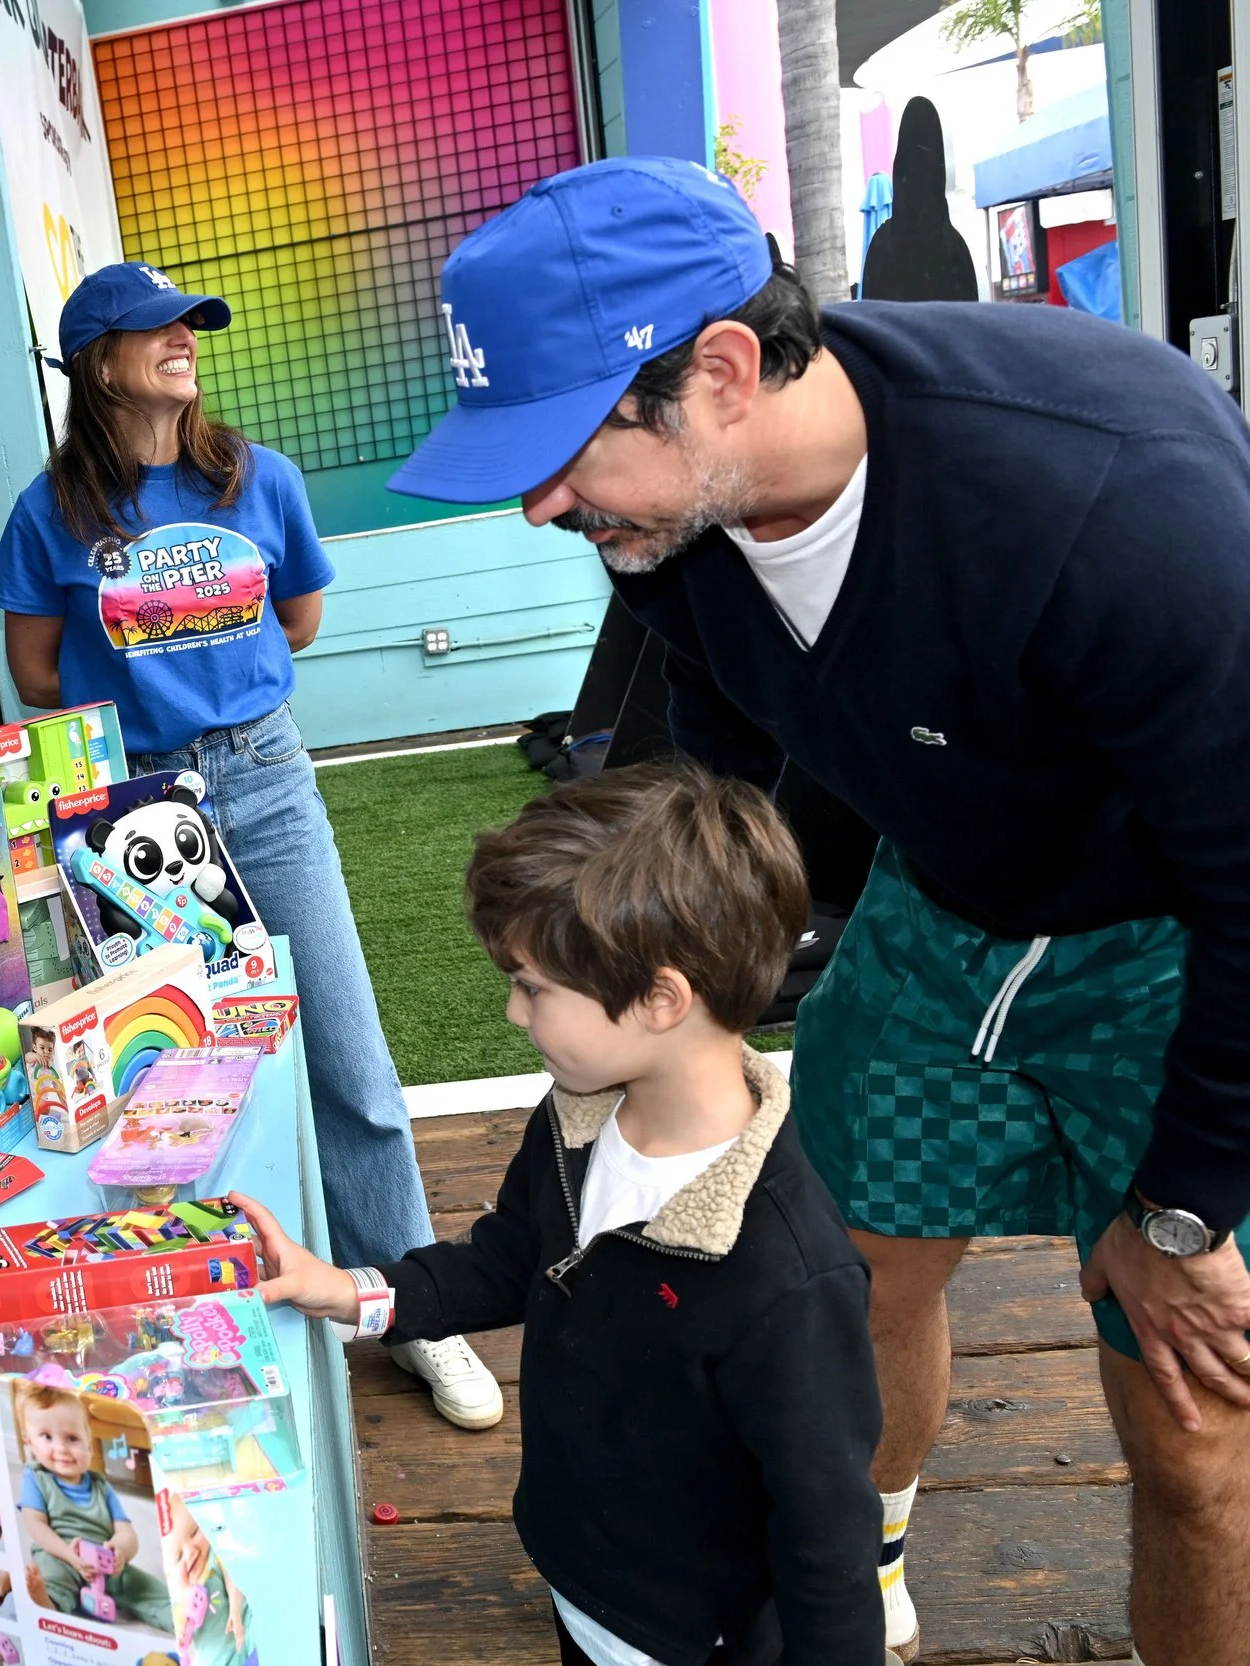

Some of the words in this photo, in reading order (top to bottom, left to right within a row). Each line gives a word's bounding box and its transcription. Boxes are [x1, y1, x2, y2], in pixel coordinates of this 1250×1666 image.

[442, 304, 489, 388] LA
[103, 551, 122, 566] 25
[137, 536, 222, 572] PARTY
[105, 565, 124, 573] YEARS
[142, 572, 160, 585] ON
[161, 561, 226, 590] PIER
[140, 583, 163, 594] THE
[195, 582, 231, 599] 2025
[166, 641, 209, 653] CHILDREN'S
[210, 635, 234, 646] HEALTH
[236, 632, 245, 640] AT
[75, 761, 82, 769] 15
[77, 773, 85, 781] 14
[58, 793, 106, 811] fisher-price
[106, 940, 121, 951] Proven
[110, 943, 128, 957] Promote
[108, 950, 129, 964] Learning!
[251, 960, 258, 968] 9
[213, 976, 239, 990] Panda
[212, 1000, 294, 1020] UNO
[61, 1012, 96, 1035] fisher-price
[204, 1035, 212, 1046] 18
[99, 1048, 105, 1061] 6
[79, 1100, 101, 1116] Develops
[43, 1619, 62, 1633] Let's
[63, 1626, 83, 1640] learn
[85, 1632, 112, 1649] about:
